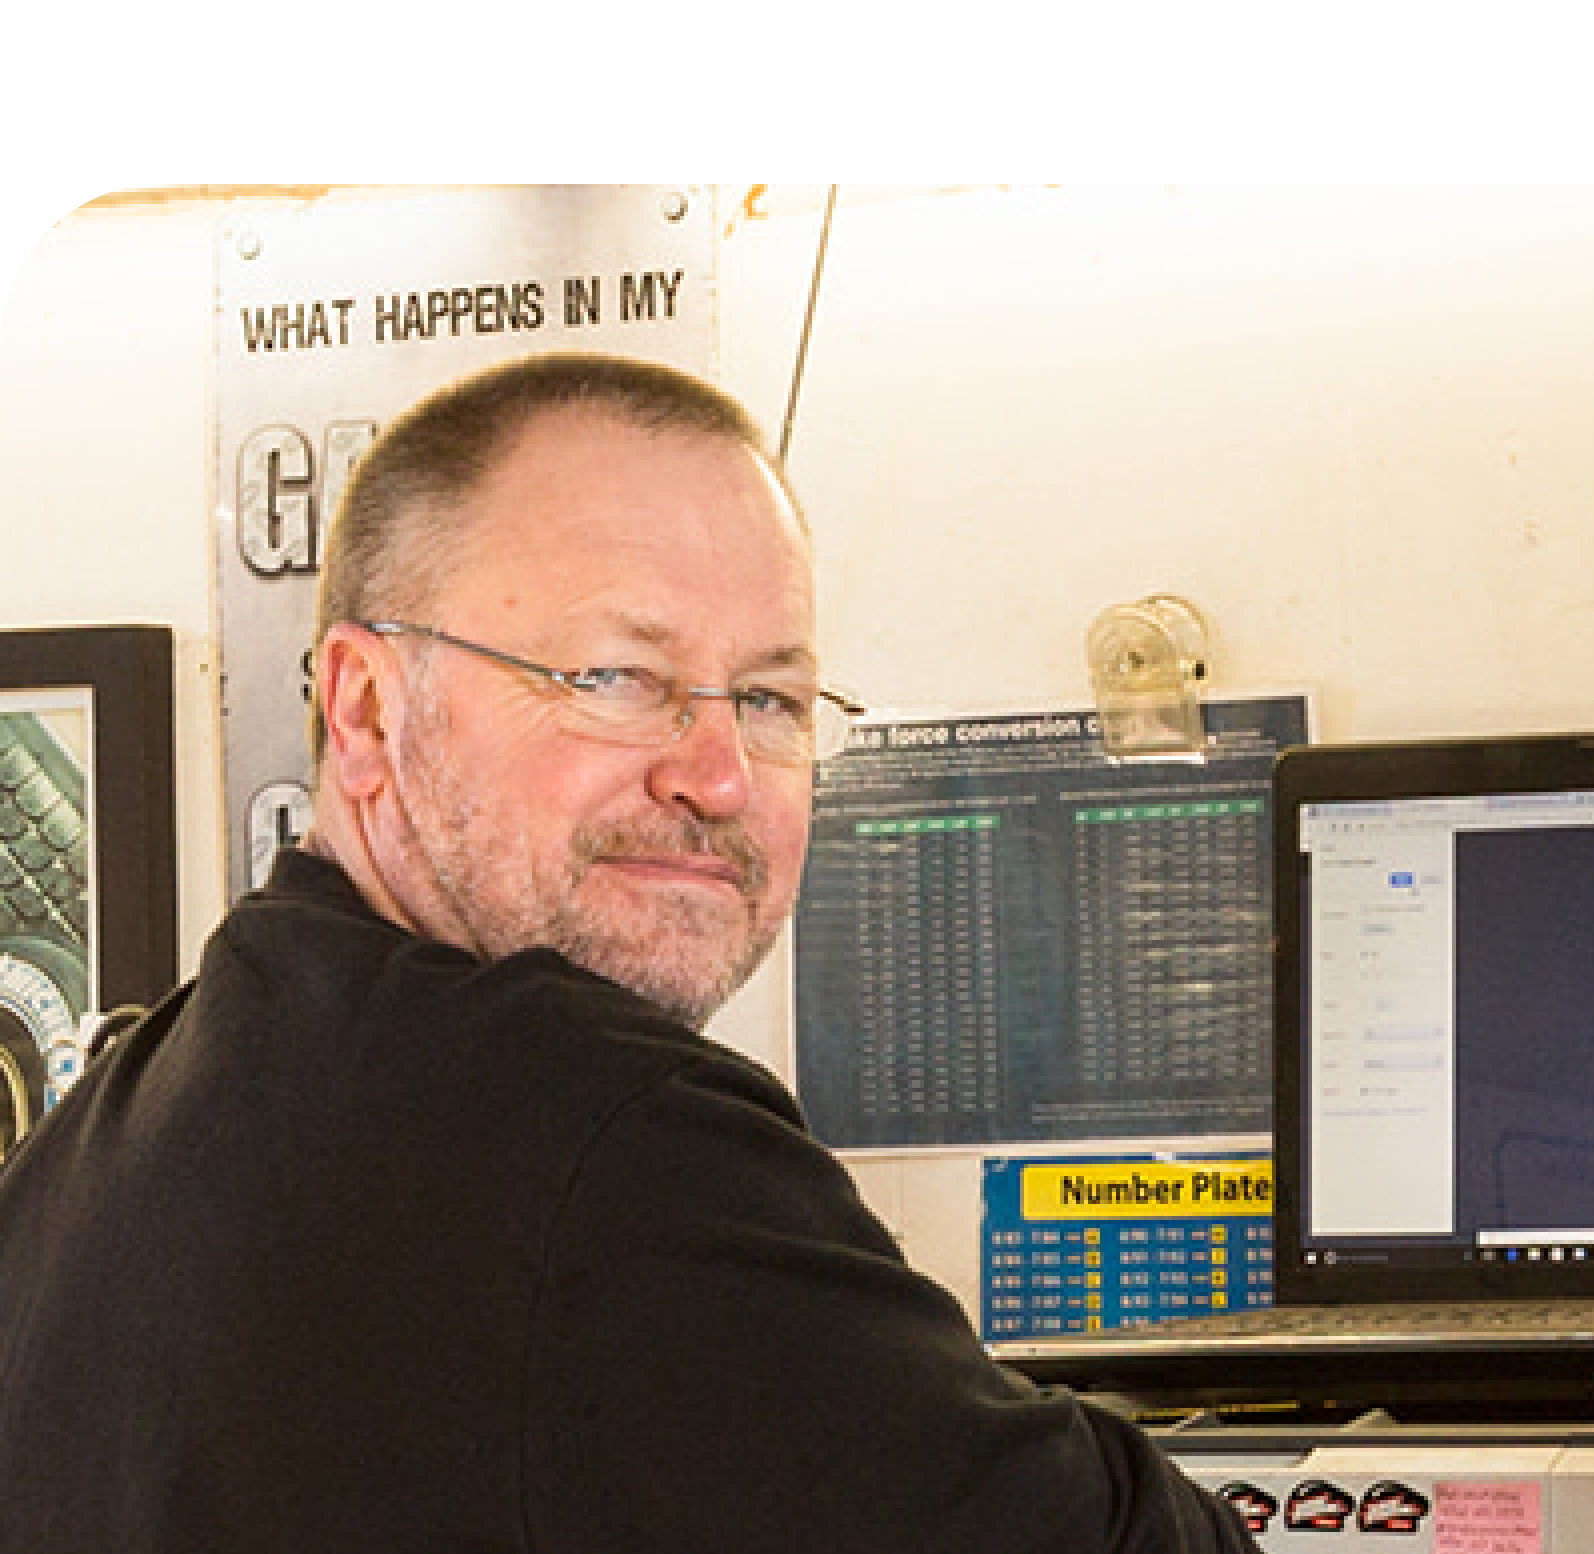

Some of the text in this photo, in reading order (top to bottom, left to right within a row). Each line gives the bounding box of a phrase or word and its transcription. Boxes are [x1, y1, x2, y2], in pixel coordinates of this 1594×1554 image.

[243, 268, 684, 353] WHAT HAPPENS IN MY
[955, 719, 1081, 741] conversion
[1060, 1170, 1185, 1205] Number
